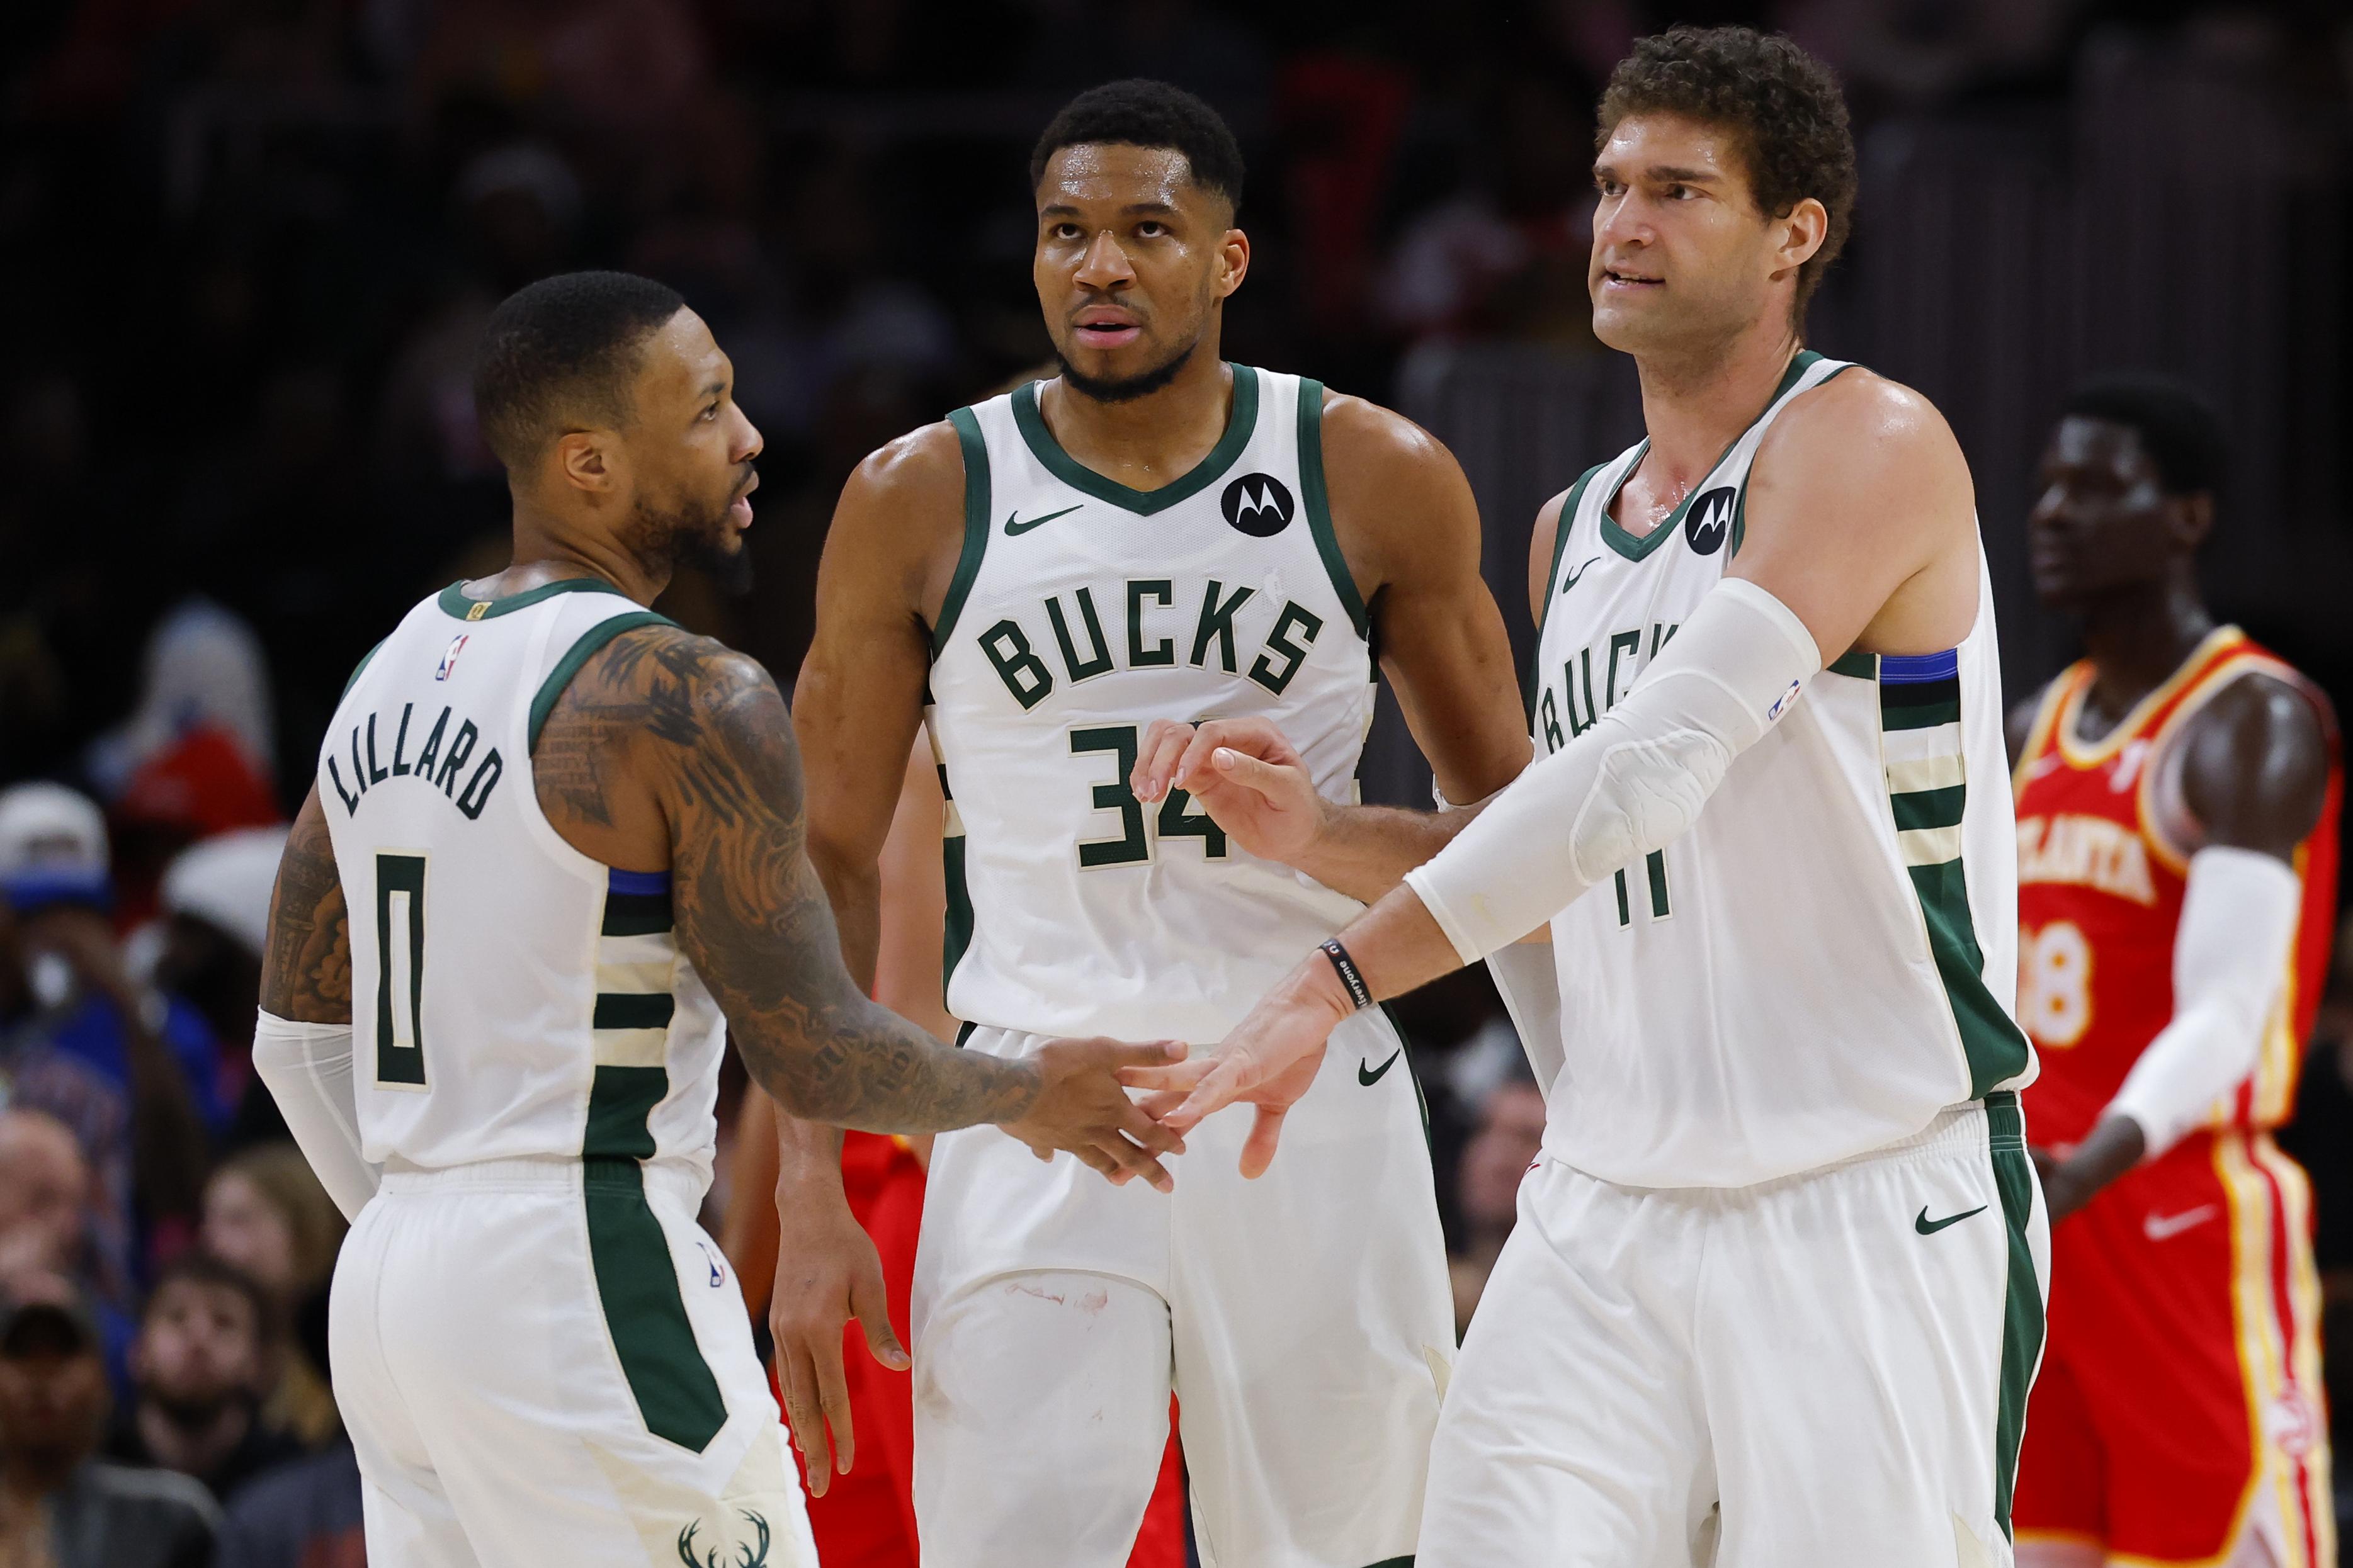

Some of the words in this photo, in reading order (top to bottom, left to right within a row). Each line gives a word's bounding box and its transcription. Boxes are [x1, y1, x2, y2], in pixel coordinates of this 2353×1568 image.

[977, 577, 1324, 713] BUCKS
[327, 702, 502, 820] LILLARD
[374, 848, 431, 1091] 0
[2016, 922, 2094, 1049] 8
